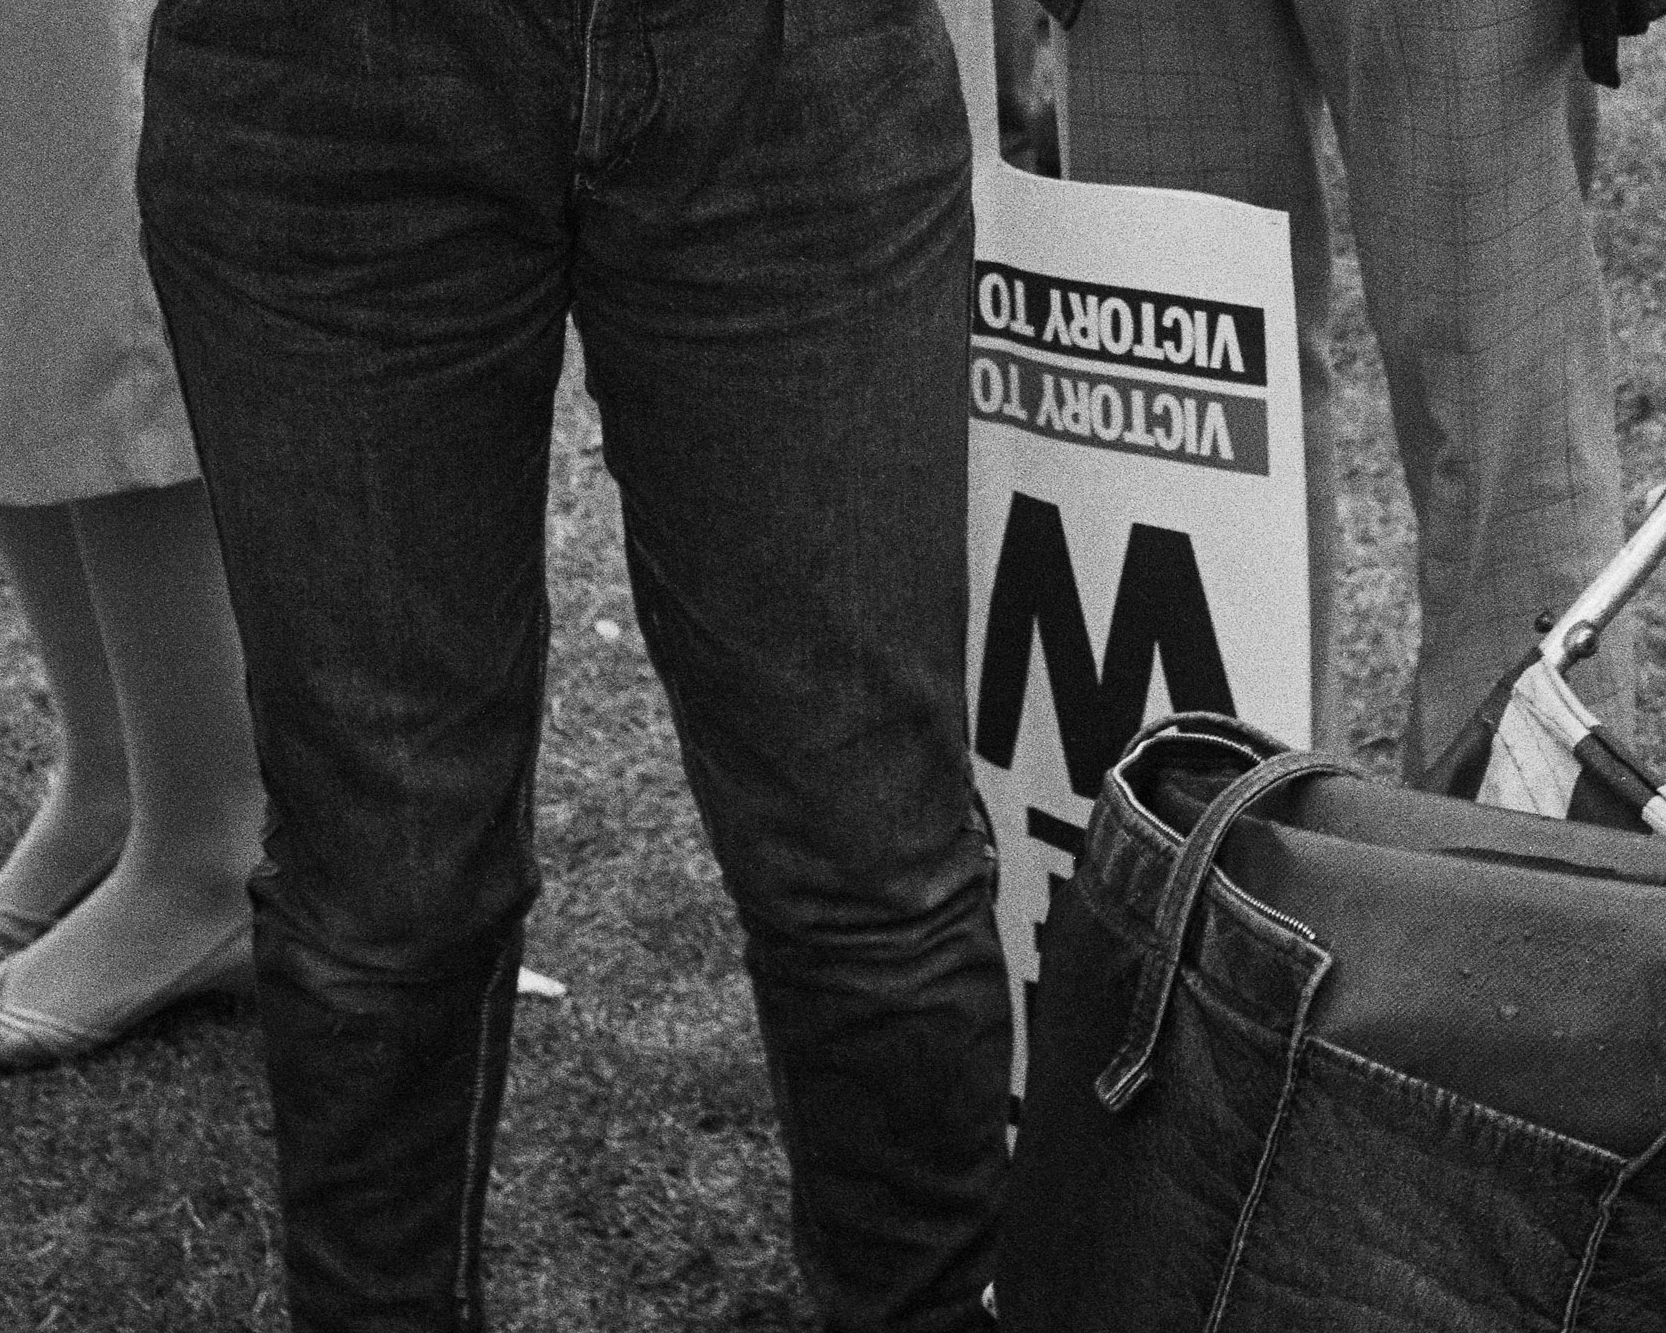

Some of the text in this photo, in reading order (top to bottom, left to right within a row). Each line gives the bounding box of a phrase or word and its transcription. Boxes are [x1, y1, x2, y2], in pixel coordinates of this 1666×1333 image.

[978, 271, 1245, 371] VICTORY TO
[971, 357, 1235, 461] VICTORY TO
